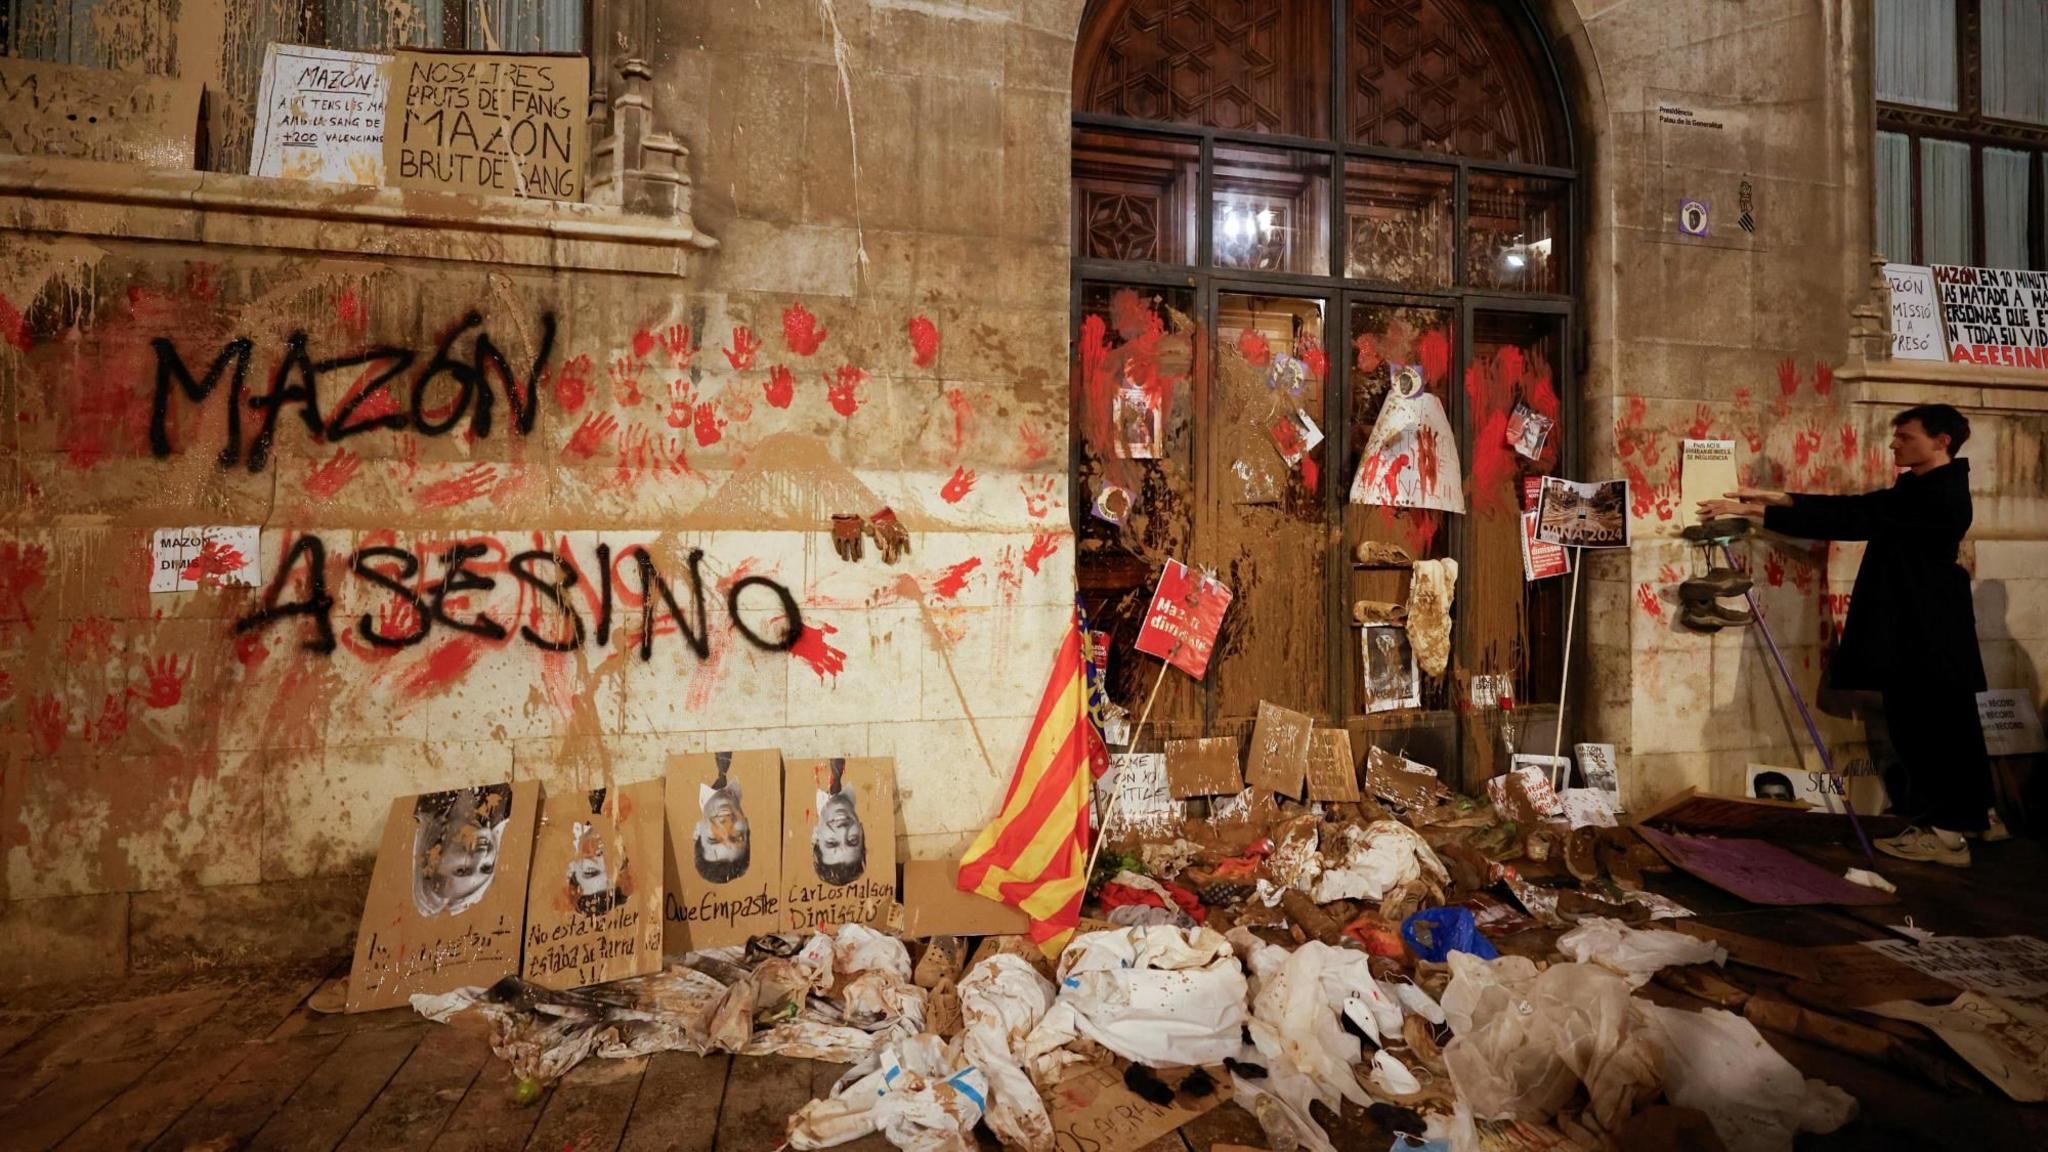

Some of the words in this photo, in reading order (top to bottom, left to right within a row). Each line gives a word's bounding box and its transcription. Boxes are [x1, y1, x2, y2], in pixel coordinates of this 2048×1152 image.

[406, 84, 470, 109] BRUTS
[512, 90, 571, 119] FANG
[329, 117, 360, 128] SANG
[365, 119, 381, 128] DE
[1659, 115, 1676, 124] Palau
[1692, 119, 1723, 130] Generalitat
[402, 109, 571, 163] MAZÓN
[401, 149, 474, 183] BRUT
[478, 156, 508, 189] DE
[1979, 269, 1999, 287] EN
[2015, 271, 2048, 291] MINUT
[1960, 286, 2009, 306] MATADO
[2014, 289, 2025, 307] A
[2006, 308, 2031, 327] QUE
[1963, 325, 1999, 345] TODA
[2000, 327, 2017, 346] SU
[149, 308, 556, 473] MAZÓN
[1587, 529, 1623, 542] 2024
[235, 533, 804, 665] ASESINO
[527, 924, 549, 948] No
